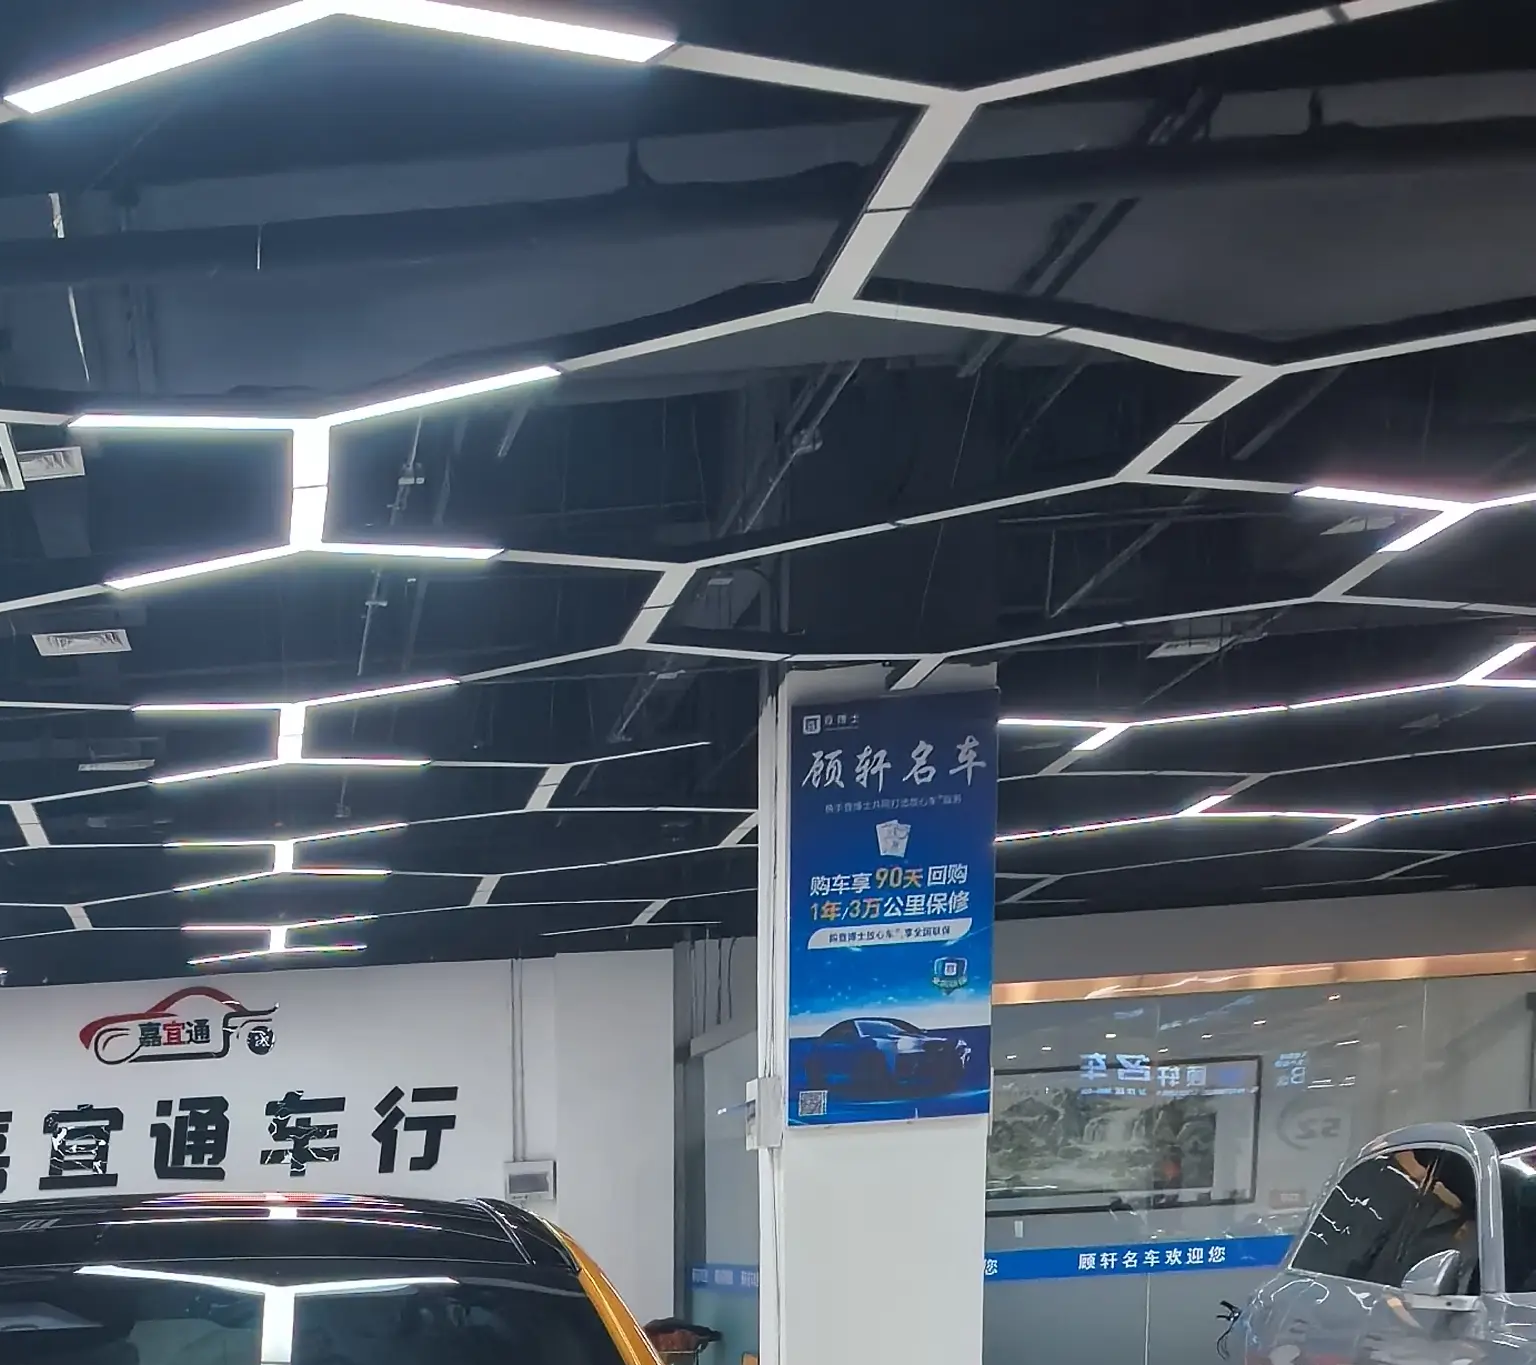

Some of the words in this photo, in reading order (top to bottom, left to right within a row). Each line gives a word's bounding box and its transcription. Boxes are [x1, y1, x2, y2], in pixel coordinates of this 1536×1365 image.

[802, 735, 987, 793] 顾轩名车
[810, 890, 970, 921] 1年/3万公里保修
[137, 1018, 212, 1048] 嘉宜通
[1078, 1246, 1226, 1271] 顾轩名车欢迎您
